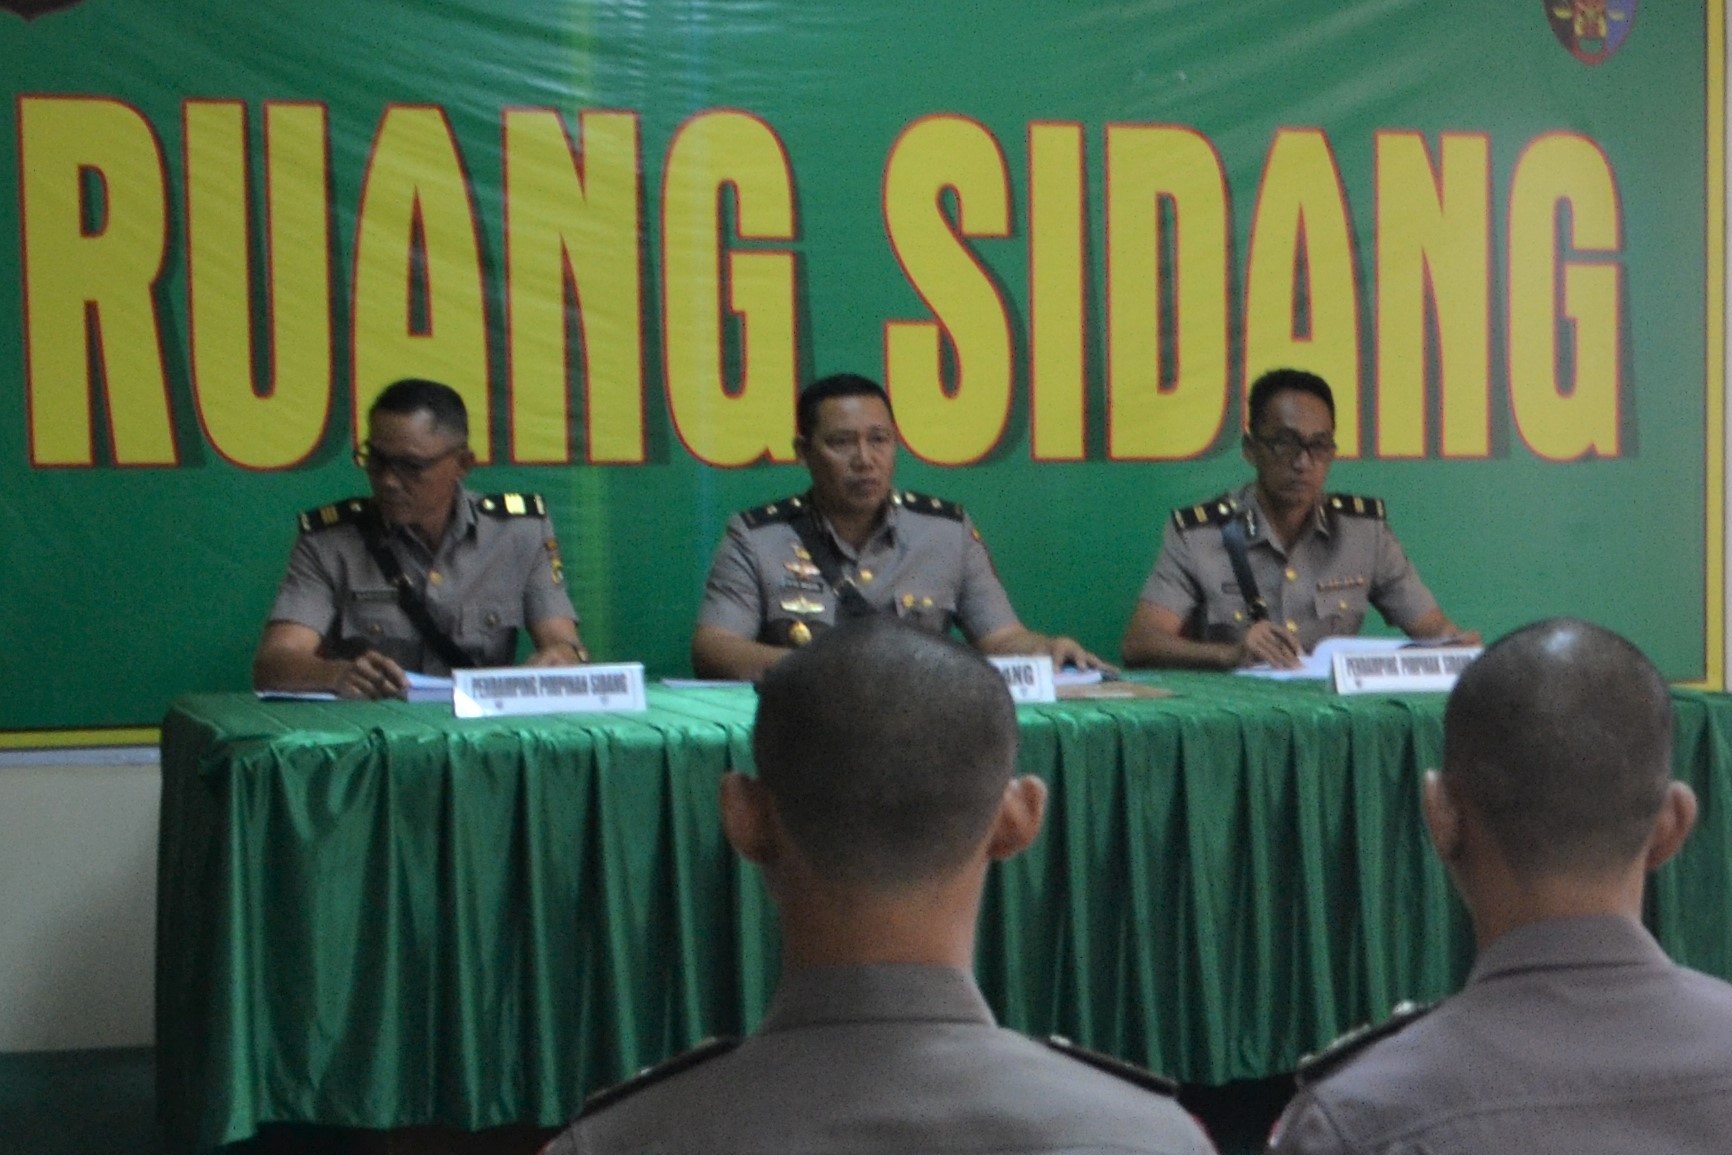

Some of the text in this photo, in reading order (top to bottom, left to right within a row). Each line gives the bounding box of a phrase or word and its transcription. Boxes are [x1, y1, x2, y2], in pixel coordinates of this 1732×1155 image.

[15, 92, 1624, 470] RUANG SIDANG
[590, 672, 627, 694] SIDANG
